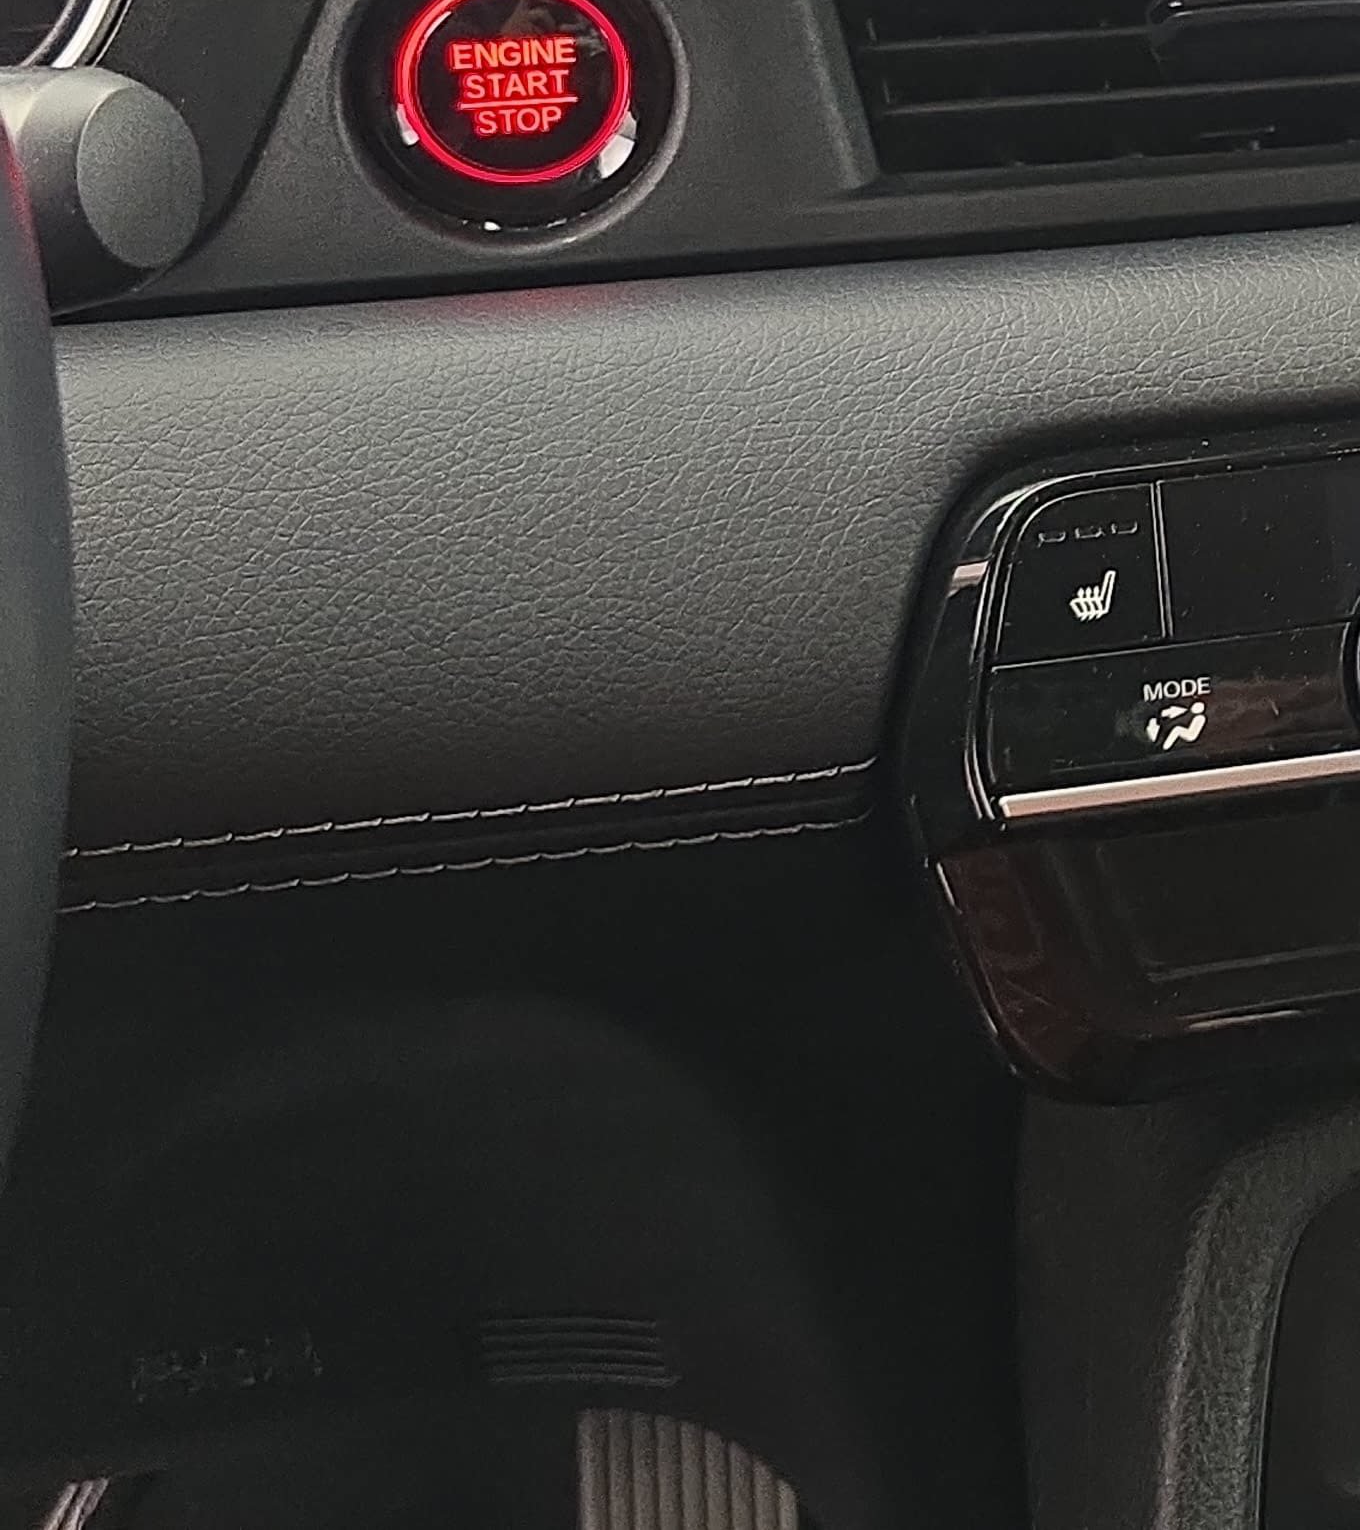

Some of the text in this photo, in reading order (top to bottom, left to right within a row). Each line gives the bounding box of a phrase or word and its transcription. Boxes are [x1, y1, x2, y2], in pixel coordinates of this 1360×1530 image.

[452, 38, 576, 69] ENGINE
[464, 71, 569, 98] START
[478, 107, 561, 134] STOP
[1143, 678, 1211, 702] MODE
